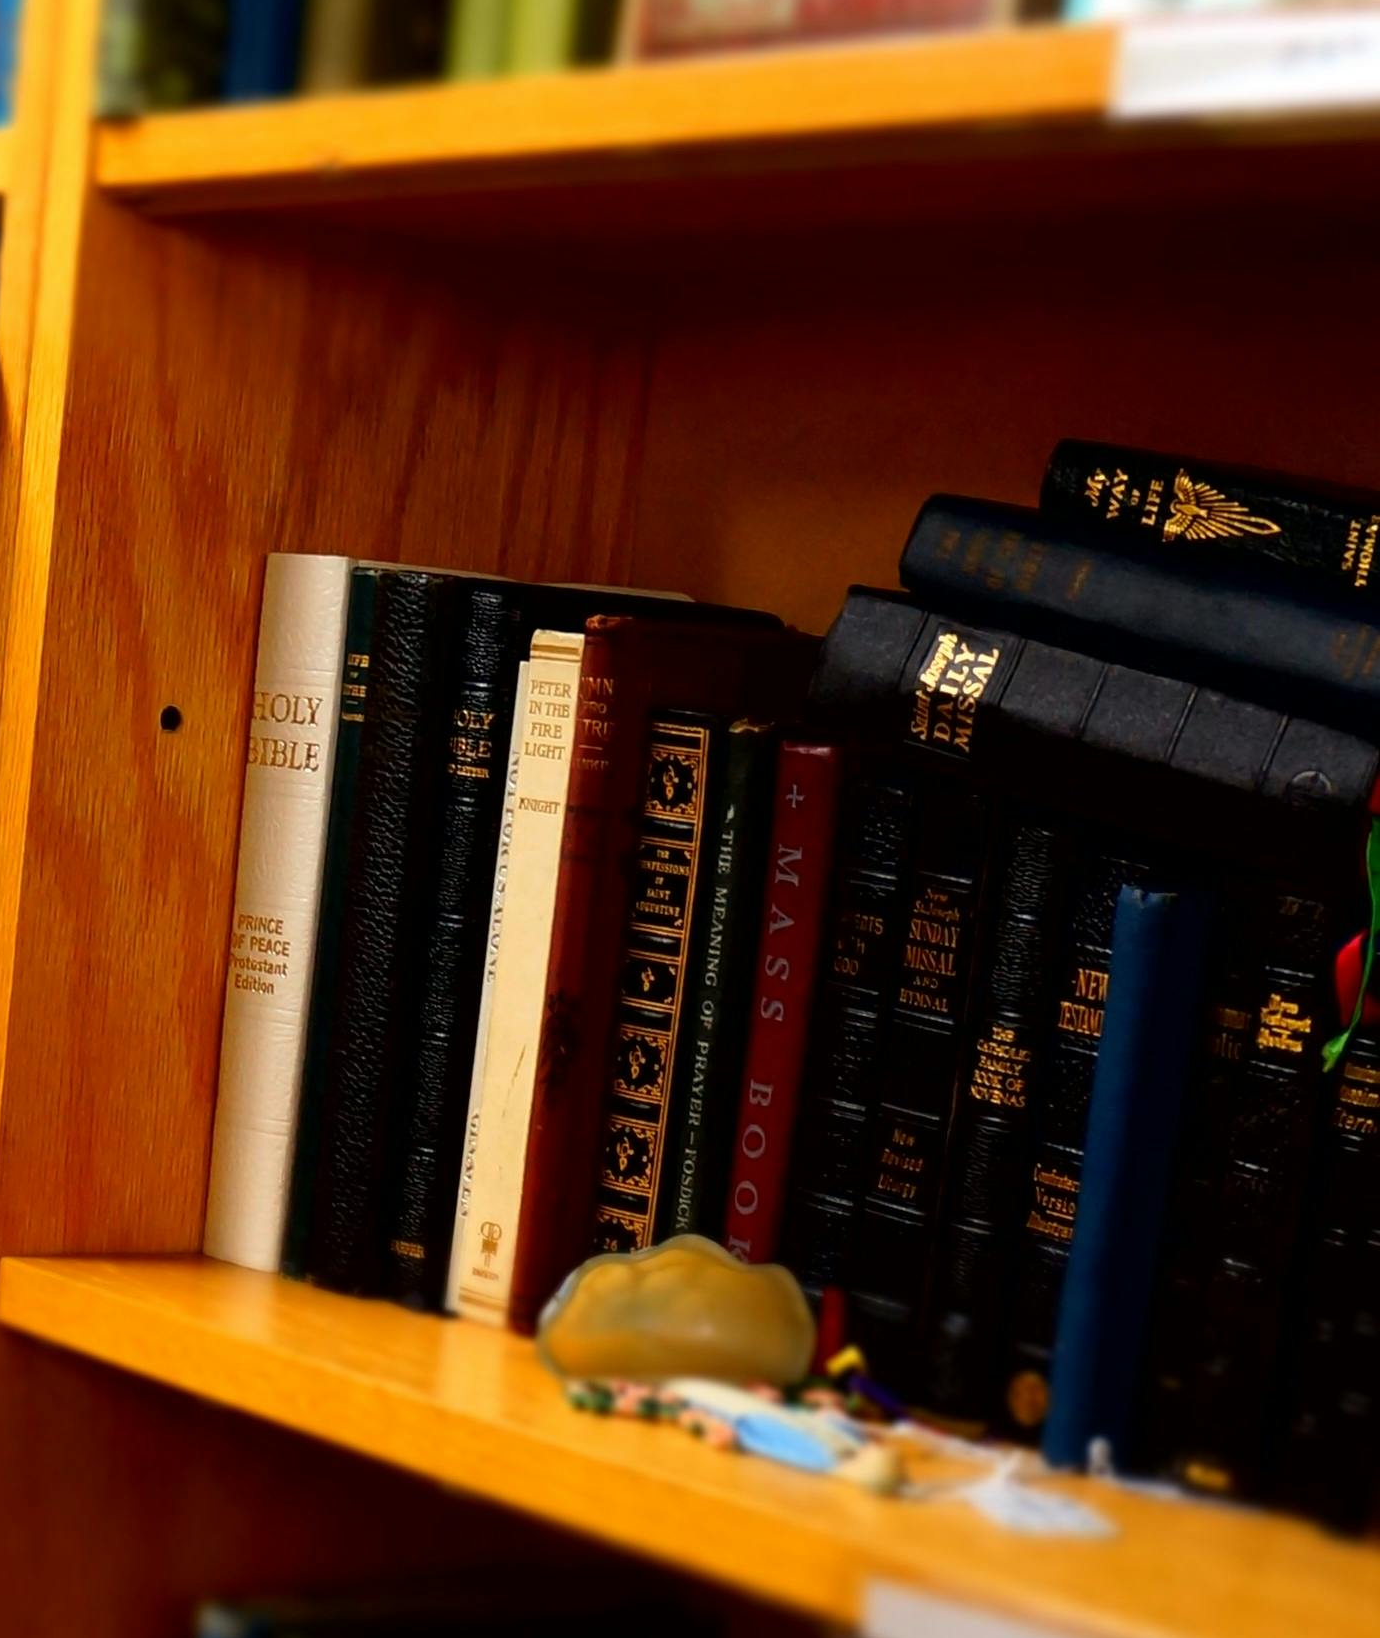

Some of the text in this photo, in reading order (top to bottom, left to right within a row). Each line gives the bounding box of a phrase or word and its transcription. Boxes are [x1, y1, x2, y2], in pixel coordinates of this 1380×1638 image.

[1084, 467, 1110, 507] My
[1106, 468, 1128, 519] WAY
[1141, 479, 1164, 526] LIFE
[1341, 519, 1362, 571] SAINT
[530, 680, 572, 700] PETER
[911, 633, 958, 741] Saint Joseph
[933, 642, 976, 742] DAILY
[251, 691, 324, 727] HOLY
[529, 700, 570, 719] IN THE
[953, 648, 1000, 753] MISSAL
[455, 709, 496, 731] OLY
[530, 721, 563, 740] FIRE
[246, 735, 321, 773] BIBLE
[524, 742, 566, 761] LIGHT
[518, 797, 561, 815] KNIGHT
[237, 914, 284, 936] PRINCE
[909, 918, 962, 949] SUNDAY
[249, 936, 291, 958] PEACE
[485, 897, 503, 983] ALONE
[904, 944, 957, 977] MISSAL
[234, 975, 275, 996] Edition
[913, 975, 939, 989] AND
[899, 987, 949, 1013] HYMNAL
[675, 830, 734, 1231] THE MEANING OF PRAYER FOSDICK
[992, 1026, 1016, 1043] THE
[727, 844, 804, 1265] MASS BOOK
[976, 1039, 1033, 1063] CATHOLIC
[978, 1055, 1024, 1077] FAMILY
[973, 1069, 1026, 1093] BOOK OF
[970, 1084, 1028, 1109] NOVENAS
[892, 1128, 917, 1147] New
[881, 1148, 924, 1173] Revised
[877, 1173, 918, 1200] Liturgy
[1034, 1186, 1077, 1215] Versio
